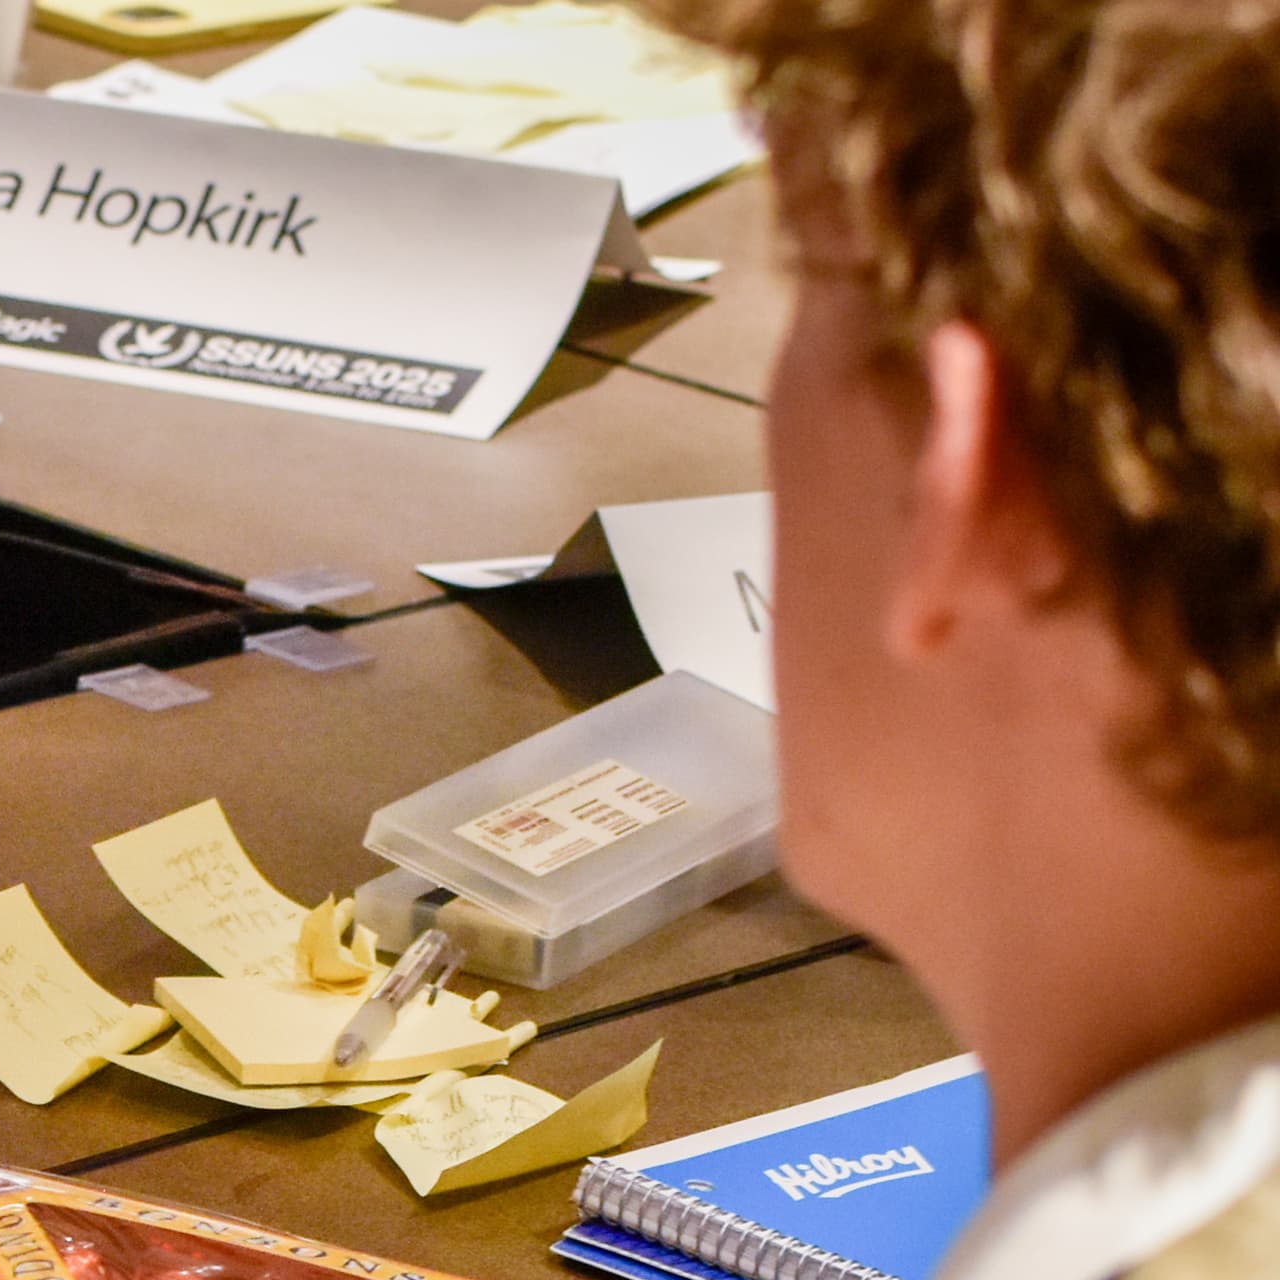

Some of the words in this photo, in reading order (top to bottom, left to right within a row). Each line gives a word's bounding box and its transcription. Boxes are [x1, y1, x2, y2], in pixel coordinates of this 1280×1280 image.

[38, 163, 317, 256] Hopkirk
[197, 335, 346, 381] SSUNS
[342, 358, 458, 397] 2025
[763, 1145, 936, 1201] Hilroy
